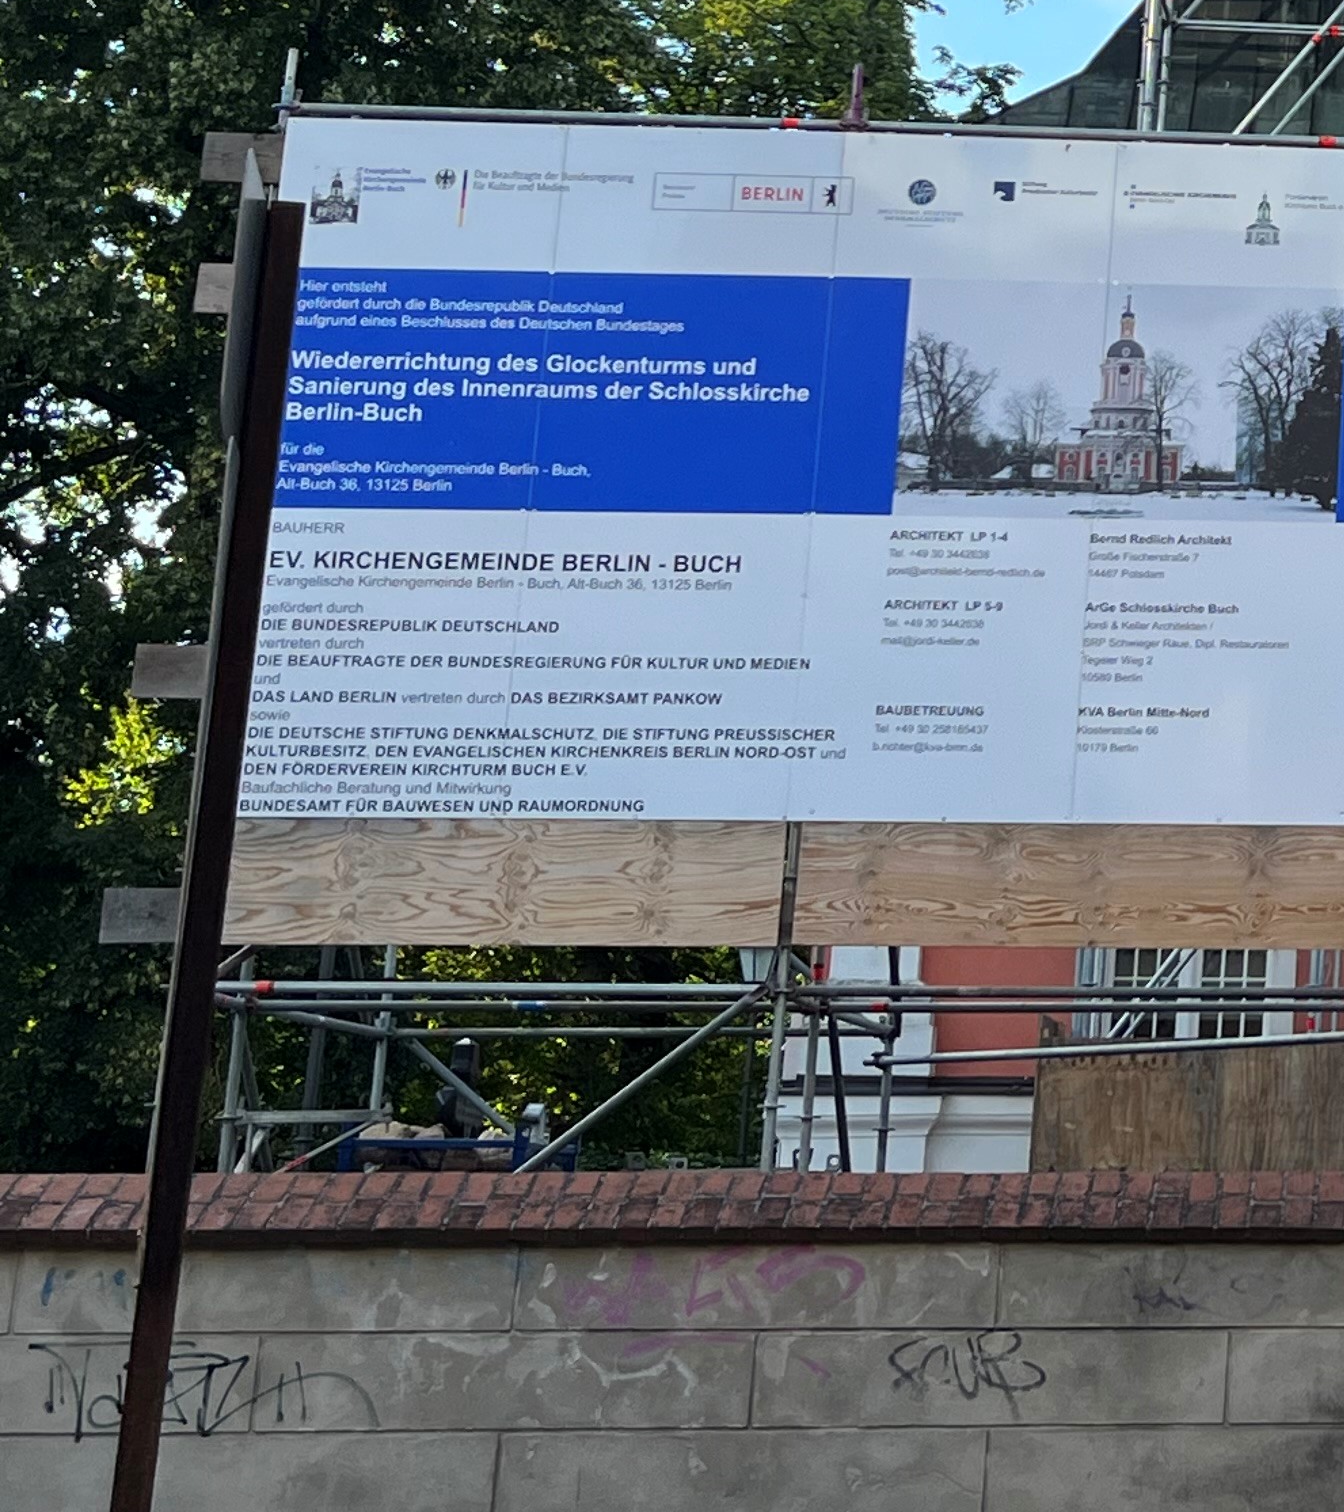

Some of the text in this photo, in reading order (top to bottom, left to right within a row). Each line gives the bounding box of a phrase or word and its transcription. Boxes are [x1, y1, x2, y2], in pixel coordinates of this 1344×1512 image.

[741, 185, 804, 202] BERLIN
[299, 280, 386, 293] Hier entsteht
[296, 298, 623, 314] gefördert durch die Bundesrepublik Deutschland
[294, 315, 684, 334] aufgrund eines Beschlusses des Deutschen Bundestages
[291, 350, 756, 376] Wiedererrichtung des Glockenturms und
[287, 376, 809, 402] Sanierung des Innenraums der Schlosskirche
[285, 402, 422, 422] Berlin-Buch
[280, 442, 324, 456] für die
[278, 460, 371, 475] Evangelische
[374, 461, 495, 476] Kirchengemeinde
[498, 462, 539, 476] Berlin
[275, 477, 335, 491] Alt-Buch
[366, 478, 408, 492] 13125
[412, 478, 452, 492] Berlin
[272, 521, 344, 534] BAUHERR
[889, 530, 1008, 542] ARCHITEKT LP 1-4
[1089, 533, 1231, 546] Bernd Redlich Architekt
[269, 550, 741, 573] EV. KIRCHENGEMEINDE BERLIN BUCH
[266, 575, 354, 590] Evangelische
[357, 575, 472, 590] Kirchengemeinde
[476, 576, 514, 589] Berlin
[566, 577, 622, 590] Alt-Buch
[651, 578, 691, 591] 13125
[694, 578, 732, 591] Berlin
[263, 602, 363, 616] gefördert durch
[883, 599, 958, 611] ARCHITEKT
[964, 600, 981, 612] LP
[1084, 602, 1239, 615] ArGe Schlosskirche Buch
[261, 618, 559, 633] DIE BUNDESREPUBLIK DEUTSCHLAND
[259, 638, 364, 650] vertreten durch
[256, 653, 810, 670] DIE BEAUFTRAGTE DER BUNDESREGIERUNG FÜR KULTUR UND MEDIEN
[254, 673, 281, 685] und
[252, 690, 722, 705] DAS LAND BERLIN vertreten durch DAS BEZIRKSAMT PANKOW
[250, 709, 290, 721] sowie
[875, 705, 984, 717] BAUBETREUUNG
[1077, 706, 1209, 718] KVA Berlin Mitte-Nord
[248, 726, 273, 739] DIE
[278, 726, 364, 739] DEUTSCHE
[370, 726, 448, 740] STIFTUNG
[602, 727, 627, 741] DIE
[632, 728, 709, 741] STIFTUNG
[713, 728, 834, 741] PREUSSISCHER
[375, 745, 407, 758] DEN
[413, 745, 545, 758] EVANGELISCHEN
[550, 746, 667, 758] KIRCHENKREIS
[672, 746, 729, 759] BERLIN
[734, 746, 816, 759] NORD-OST
[820, 748, 845, 760] und
[244, 761, 276, 776] DEN
[281, 762, 407, 776] FÖRDERVEREIN
[411, 763, 506, 776] KIRCHTURM
[511, 763, 555, 776] BUCH
[241, 781, 511, 797] Baufachliche Beratung und Mitwirkung
[239, 798, 643, 815] BUNDESAMT FÜR BAUWESEN UND RAUMORDNUNG
